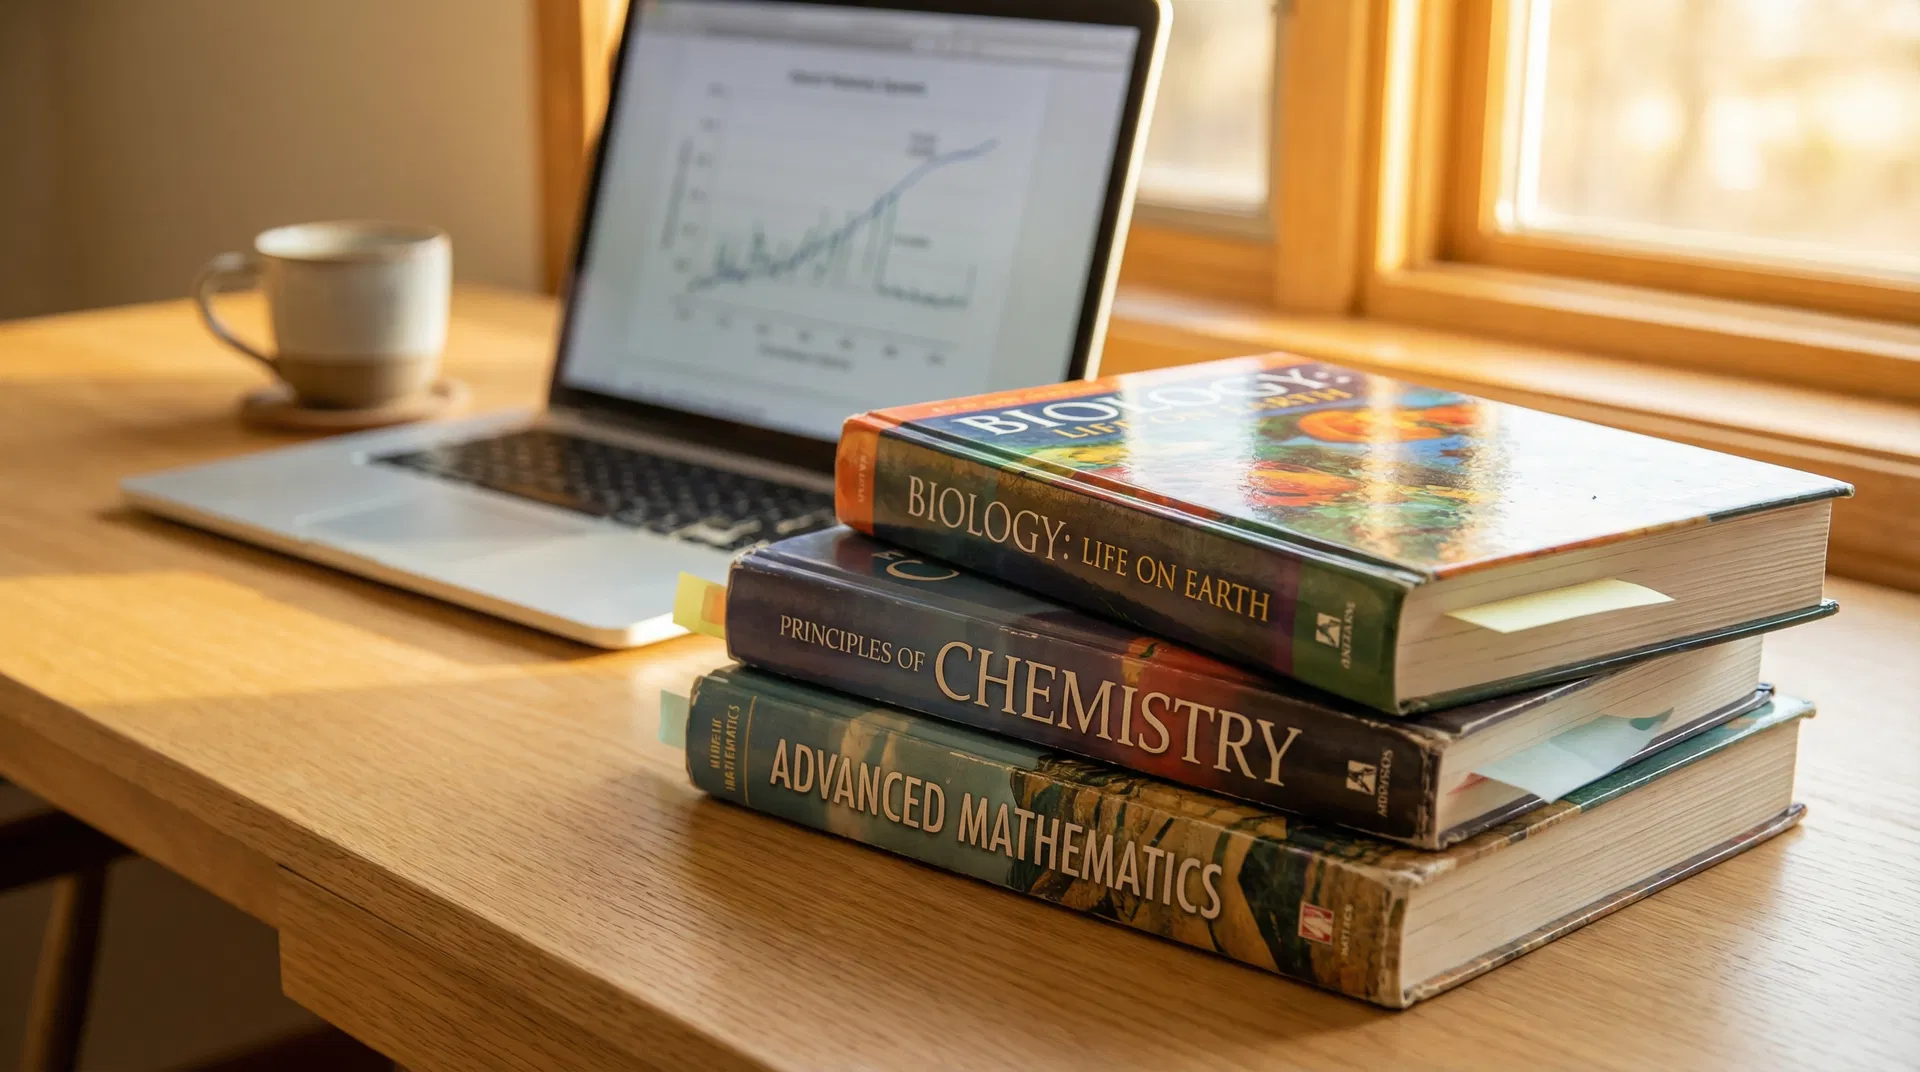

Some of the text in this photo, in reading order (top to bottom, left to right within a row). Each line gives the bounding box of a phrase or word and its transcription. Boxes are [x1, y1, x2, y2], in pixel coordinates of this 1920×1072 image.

[907, 475, 1071, 561] BIOLOGY:
[1081, 536, 1128, 577] LIFE
[1136, 555, 1177, 592] ON
[1184, 568, 1271, 622] EARTH
[779, 614, 1303, 788] PRINCIPLES OF CHEMISTRY
[770, 738, 946, 834] ADVANCED
[957, 792, 1223, 920] MATHEMATICS
